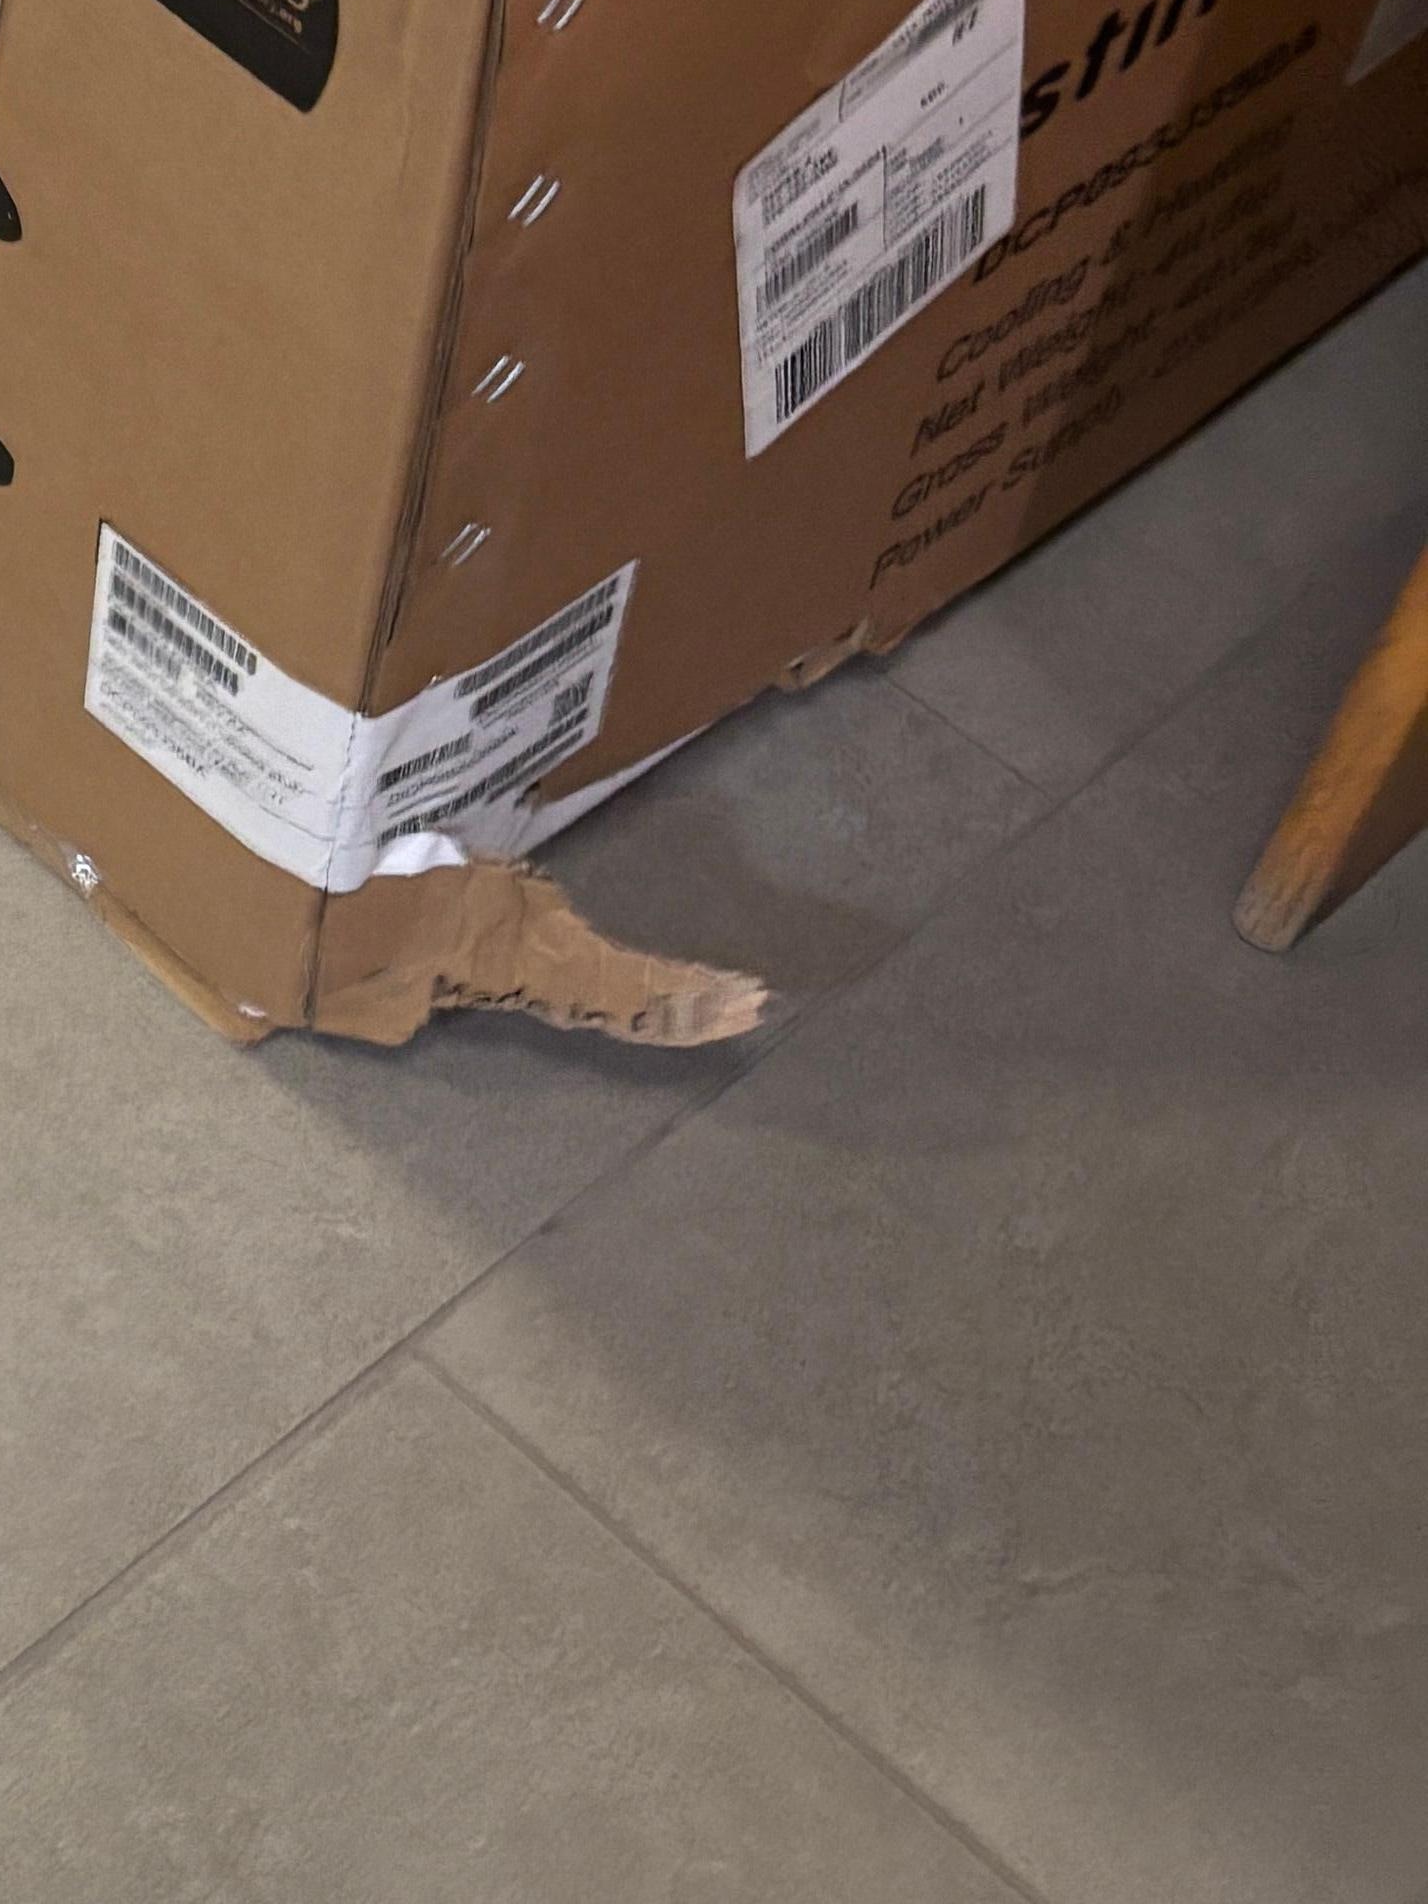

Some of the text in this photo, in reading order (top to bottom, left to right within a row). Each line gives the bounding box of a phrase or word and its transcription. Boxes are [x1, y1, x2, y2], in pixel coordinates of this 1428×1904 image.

[936, 253, 1092, 383] Cooling
[891, 421, 1010, 521] Gross
[909, 379, 986, 458] Net
[869, 478, 996, 591] Power
